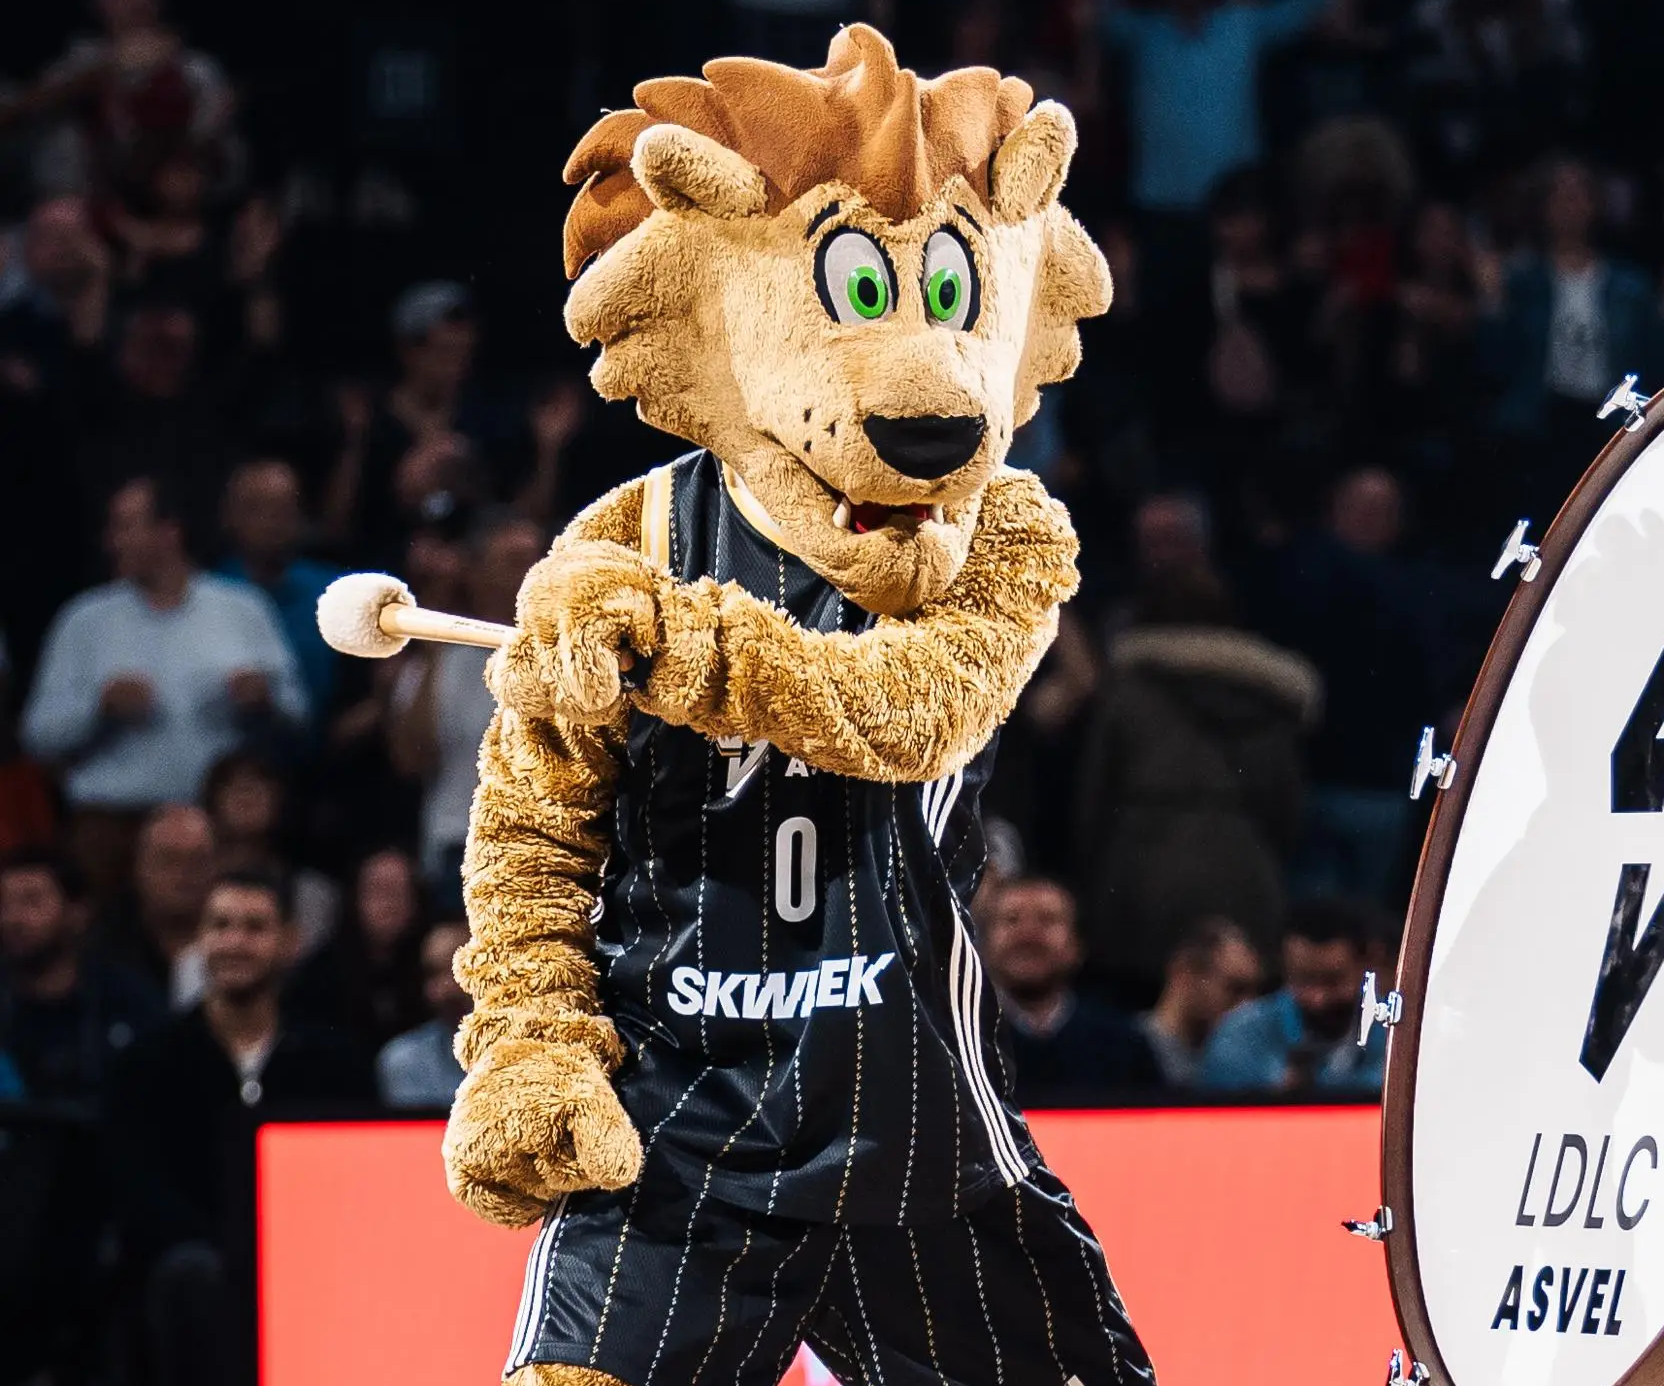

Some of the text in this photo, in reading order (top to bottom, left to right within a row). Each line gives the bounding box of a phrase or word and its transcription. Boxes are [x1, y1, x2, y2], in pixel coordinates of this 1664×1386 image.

[775, 816, 817, 923] 0
[1515, 1133, 1658, 1231] LDLC
[1490, 1265, 1626, 1336] ASVEL
